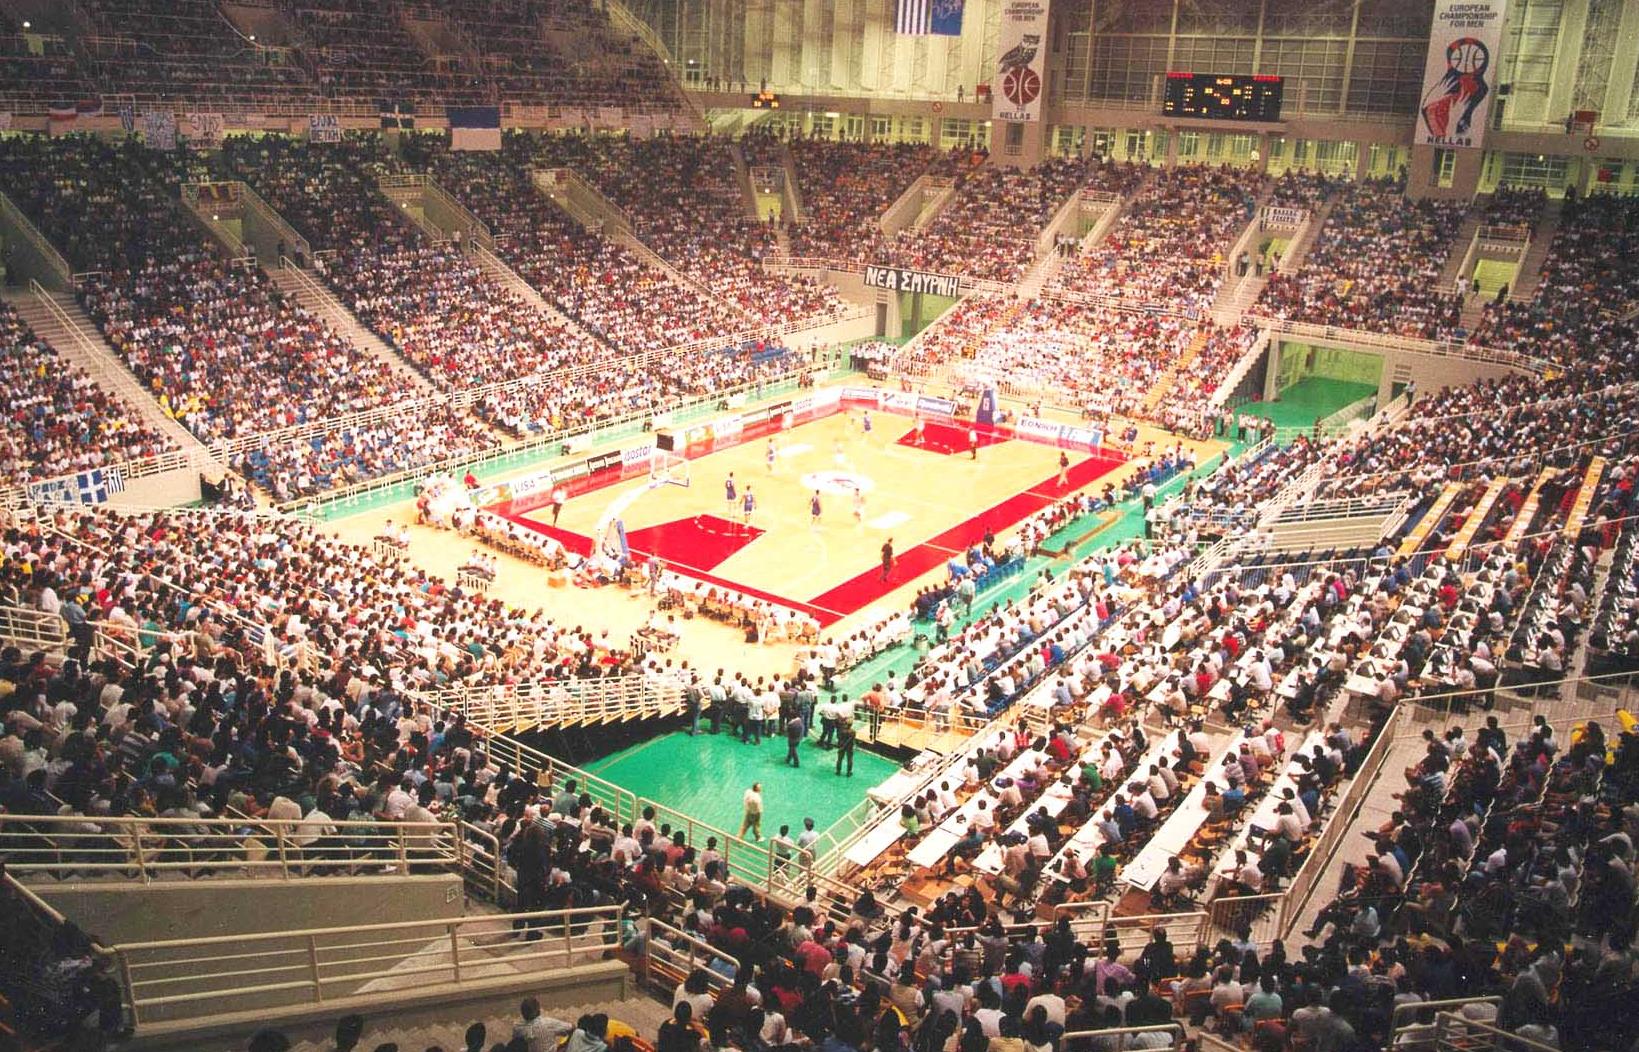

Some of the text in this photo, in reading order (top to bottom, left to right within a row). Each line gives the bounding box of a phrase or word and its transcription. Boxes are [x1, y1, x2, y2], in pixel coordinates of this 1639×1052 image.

[1449, 4, 1491, 12] EUROPEAN
[1440, 12, 1498, 20] CHAMPIONSHIP
[999, 111, 1031, 120] HELLAS
[1427, 136, 1472, 146] HELLAS
[865, 266, 958, 297] ΝΕΑ ΣΜΥΡΝΗ
[513, 479, 536, 493] VISA
